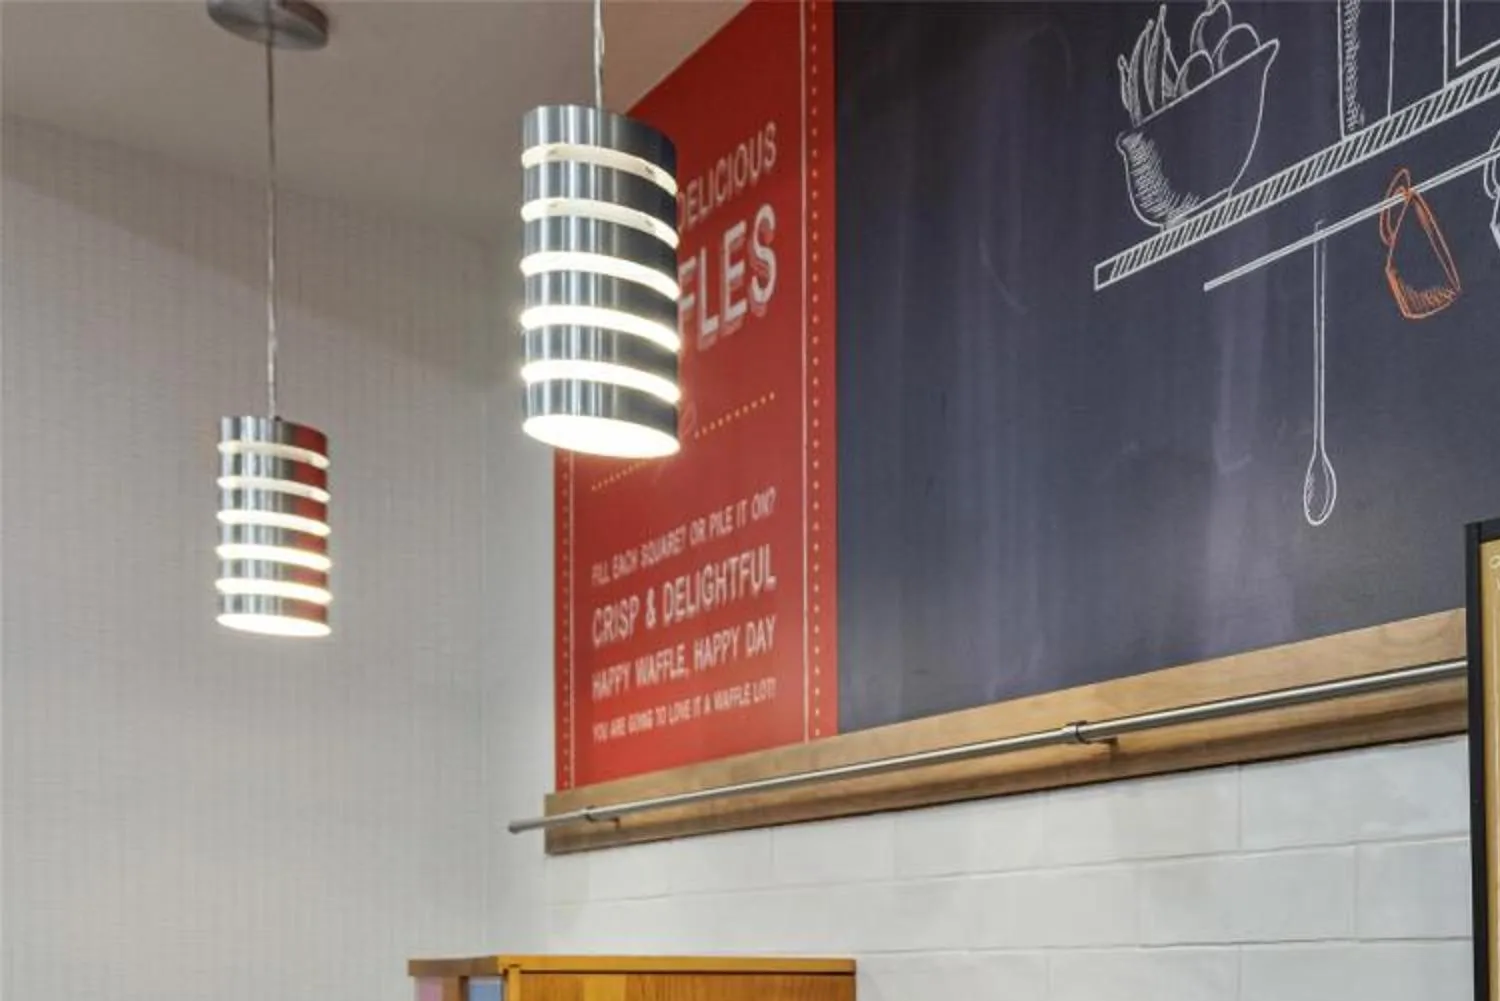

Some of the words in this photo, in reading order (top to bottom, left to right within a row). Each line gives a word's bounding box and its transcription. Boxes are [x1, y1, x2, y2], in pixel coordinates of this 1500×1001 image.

[736, 499, 748, 528] IT
[591, 594, 640, 648] CRISP
[645, 588, 657, 629] &
[662, 543, 777, 627] DELIGHTFUL
[591, 661, 631, 702] HAPPY
[693, 625, 741, 672] HAPPY
[745, 614, 777, 658] DAY
